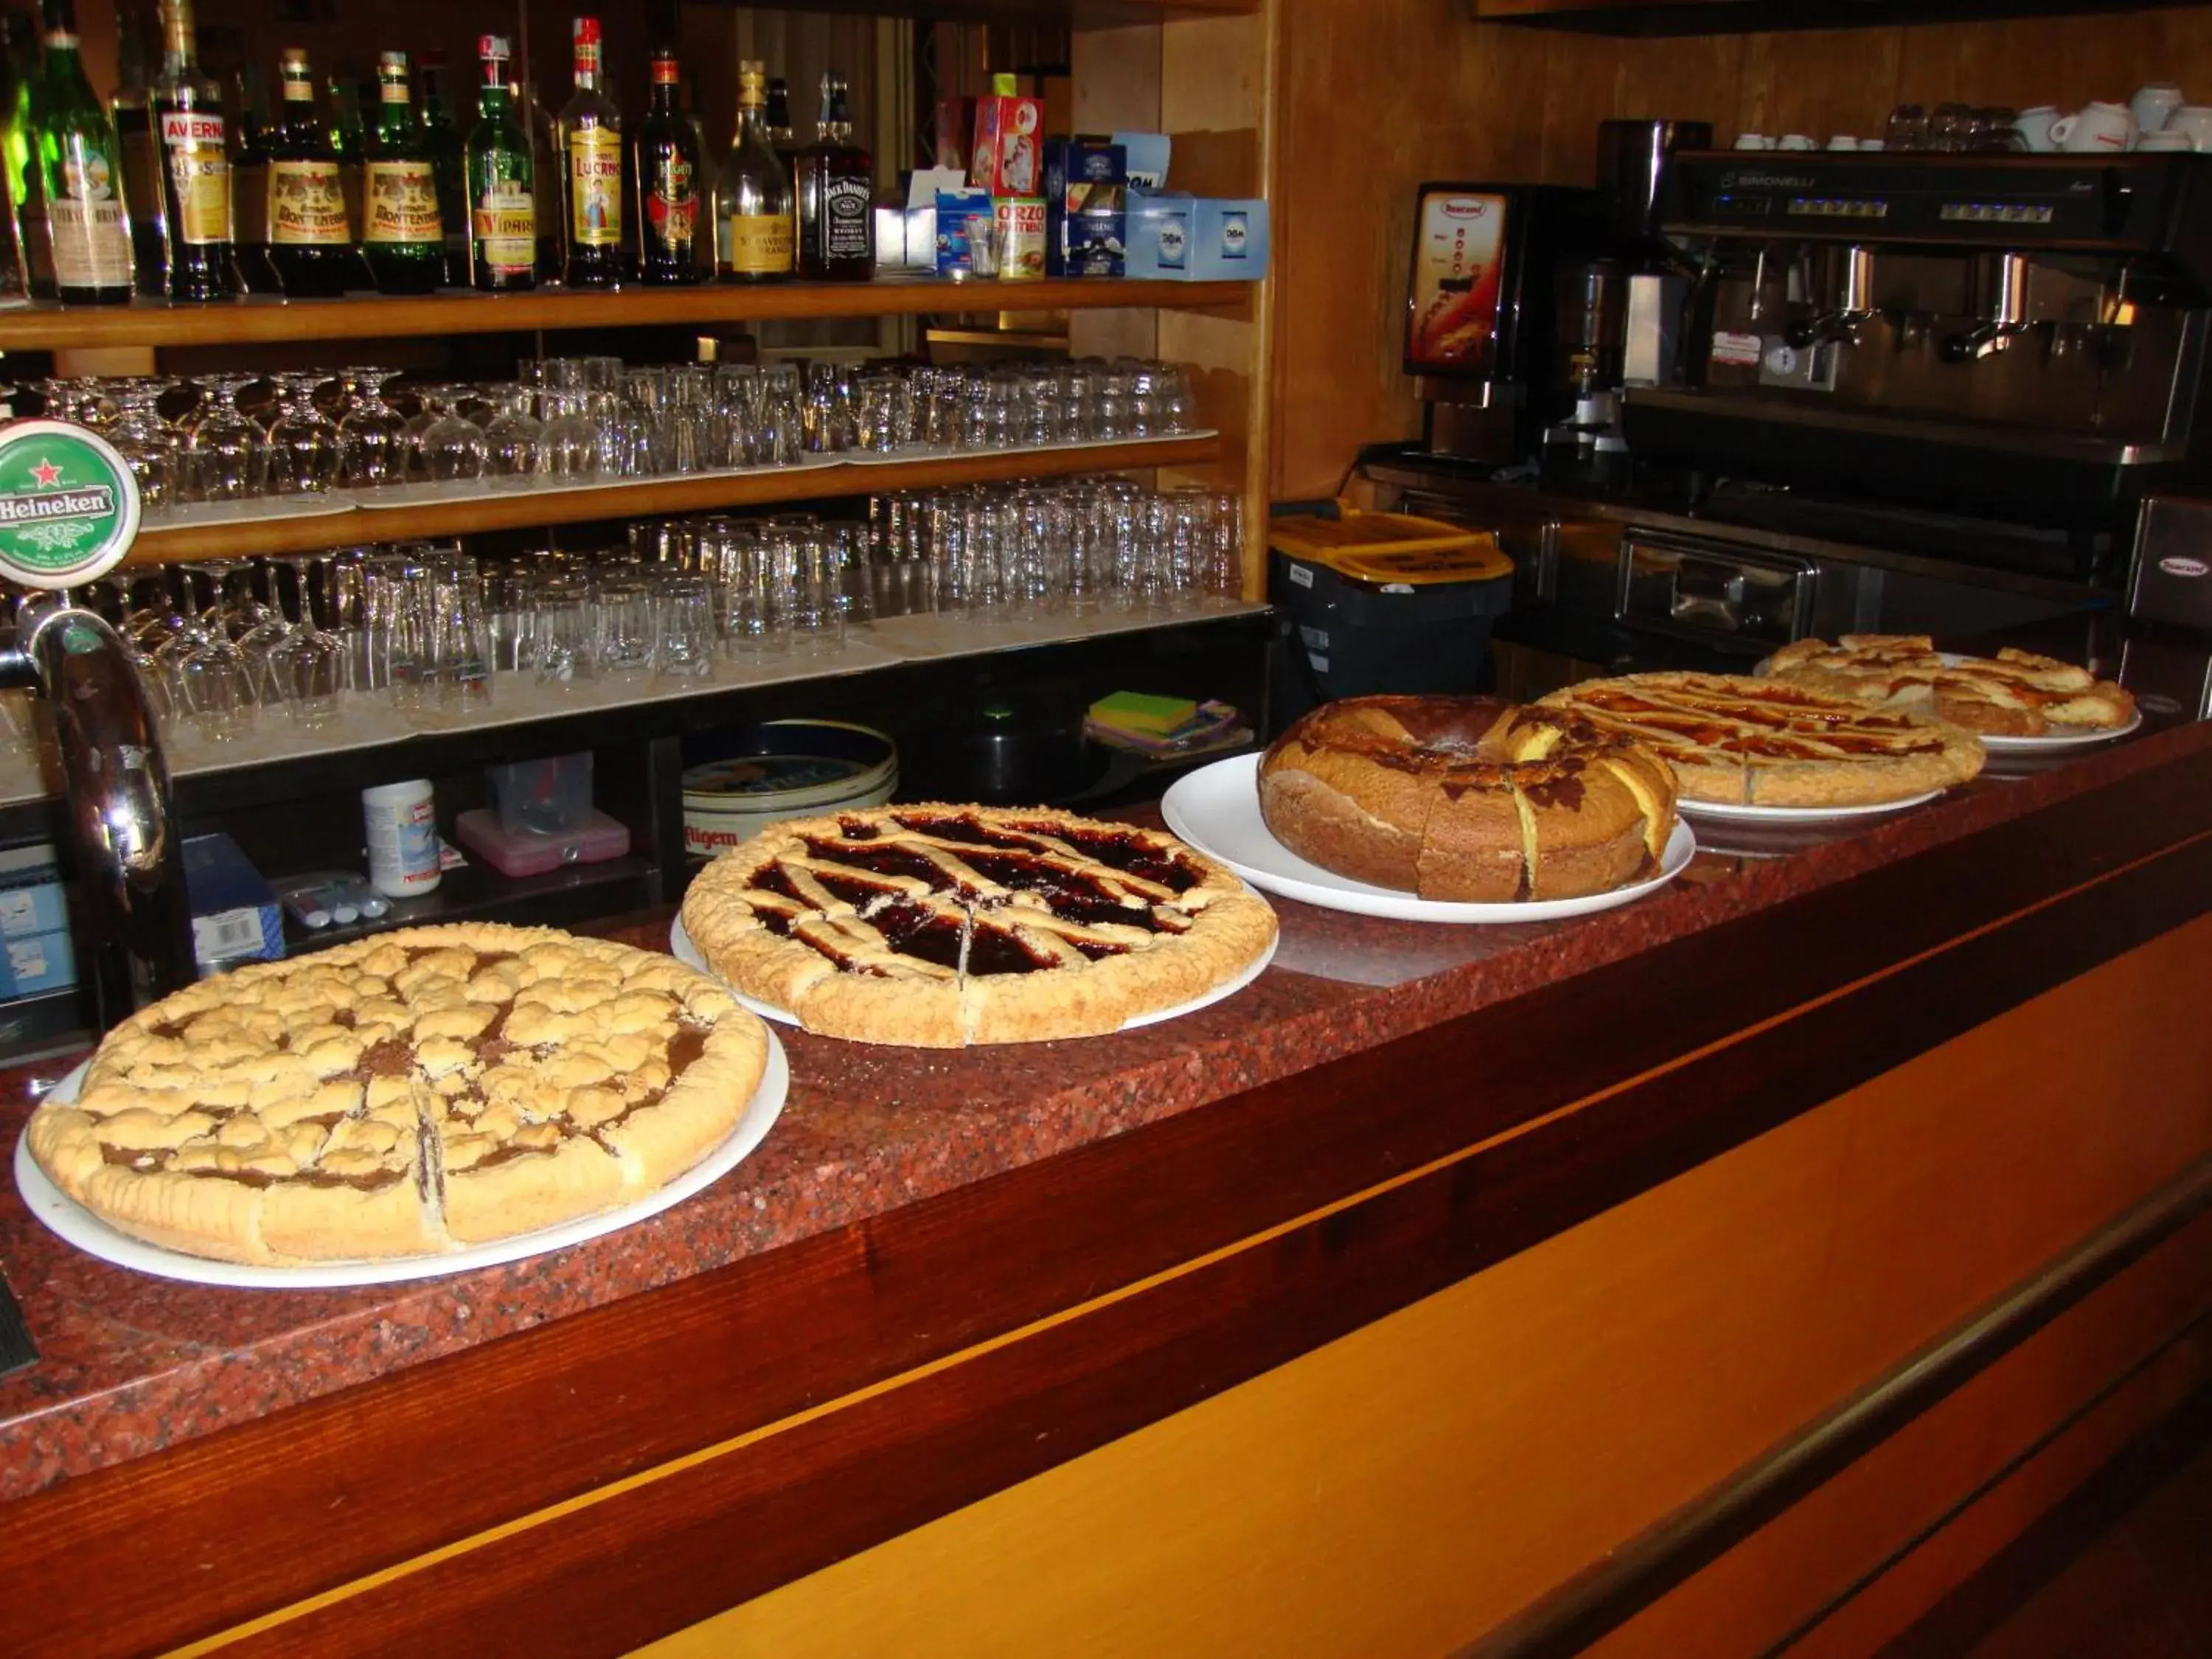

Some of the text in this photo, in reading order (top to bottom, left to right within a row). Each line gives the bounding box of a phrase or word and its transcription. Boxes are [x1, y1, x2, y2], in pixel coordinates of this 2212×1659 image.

[824, 184, 843, 201] JACK
[998, 206, 1045, 220] ORZO
[0, 495, 106, 520] Heineken
